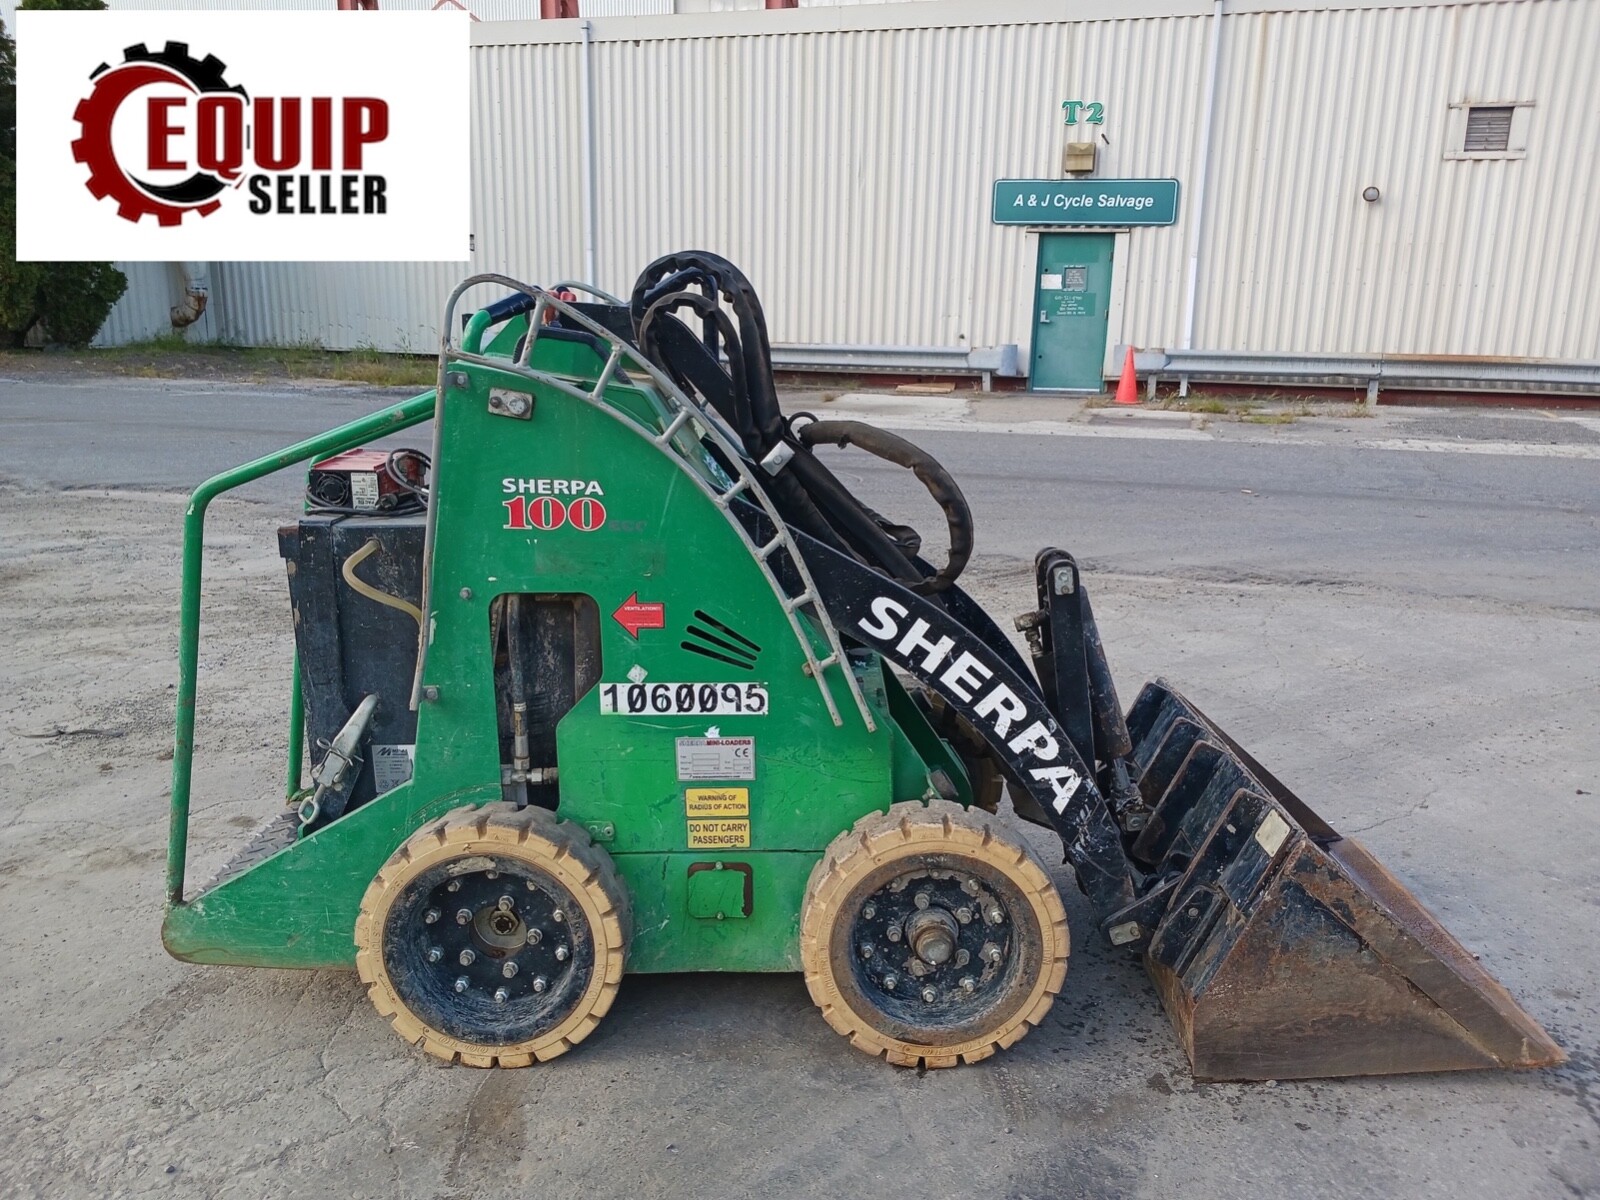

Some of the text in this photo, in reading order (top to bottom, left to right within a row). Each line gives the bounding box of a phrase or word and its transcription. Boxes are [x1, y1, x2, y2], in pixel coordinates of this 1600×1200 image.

[1062, 100, 1104, 125] T2
[1013, 194, 1154, 210] A & J Cycle Salvage
[502, 478, 604, 495] SHERPA
[502, 495, 607, 531] 100
[603, 683, 766, 713] 1060095
[857, 596, 1082, 815] SHERPA
[689, 803, 713, 811] RADIUS
[689, 823, 748, 833] DO NOT CARRY
[693, 835, 745, 844] PASSENGERS
